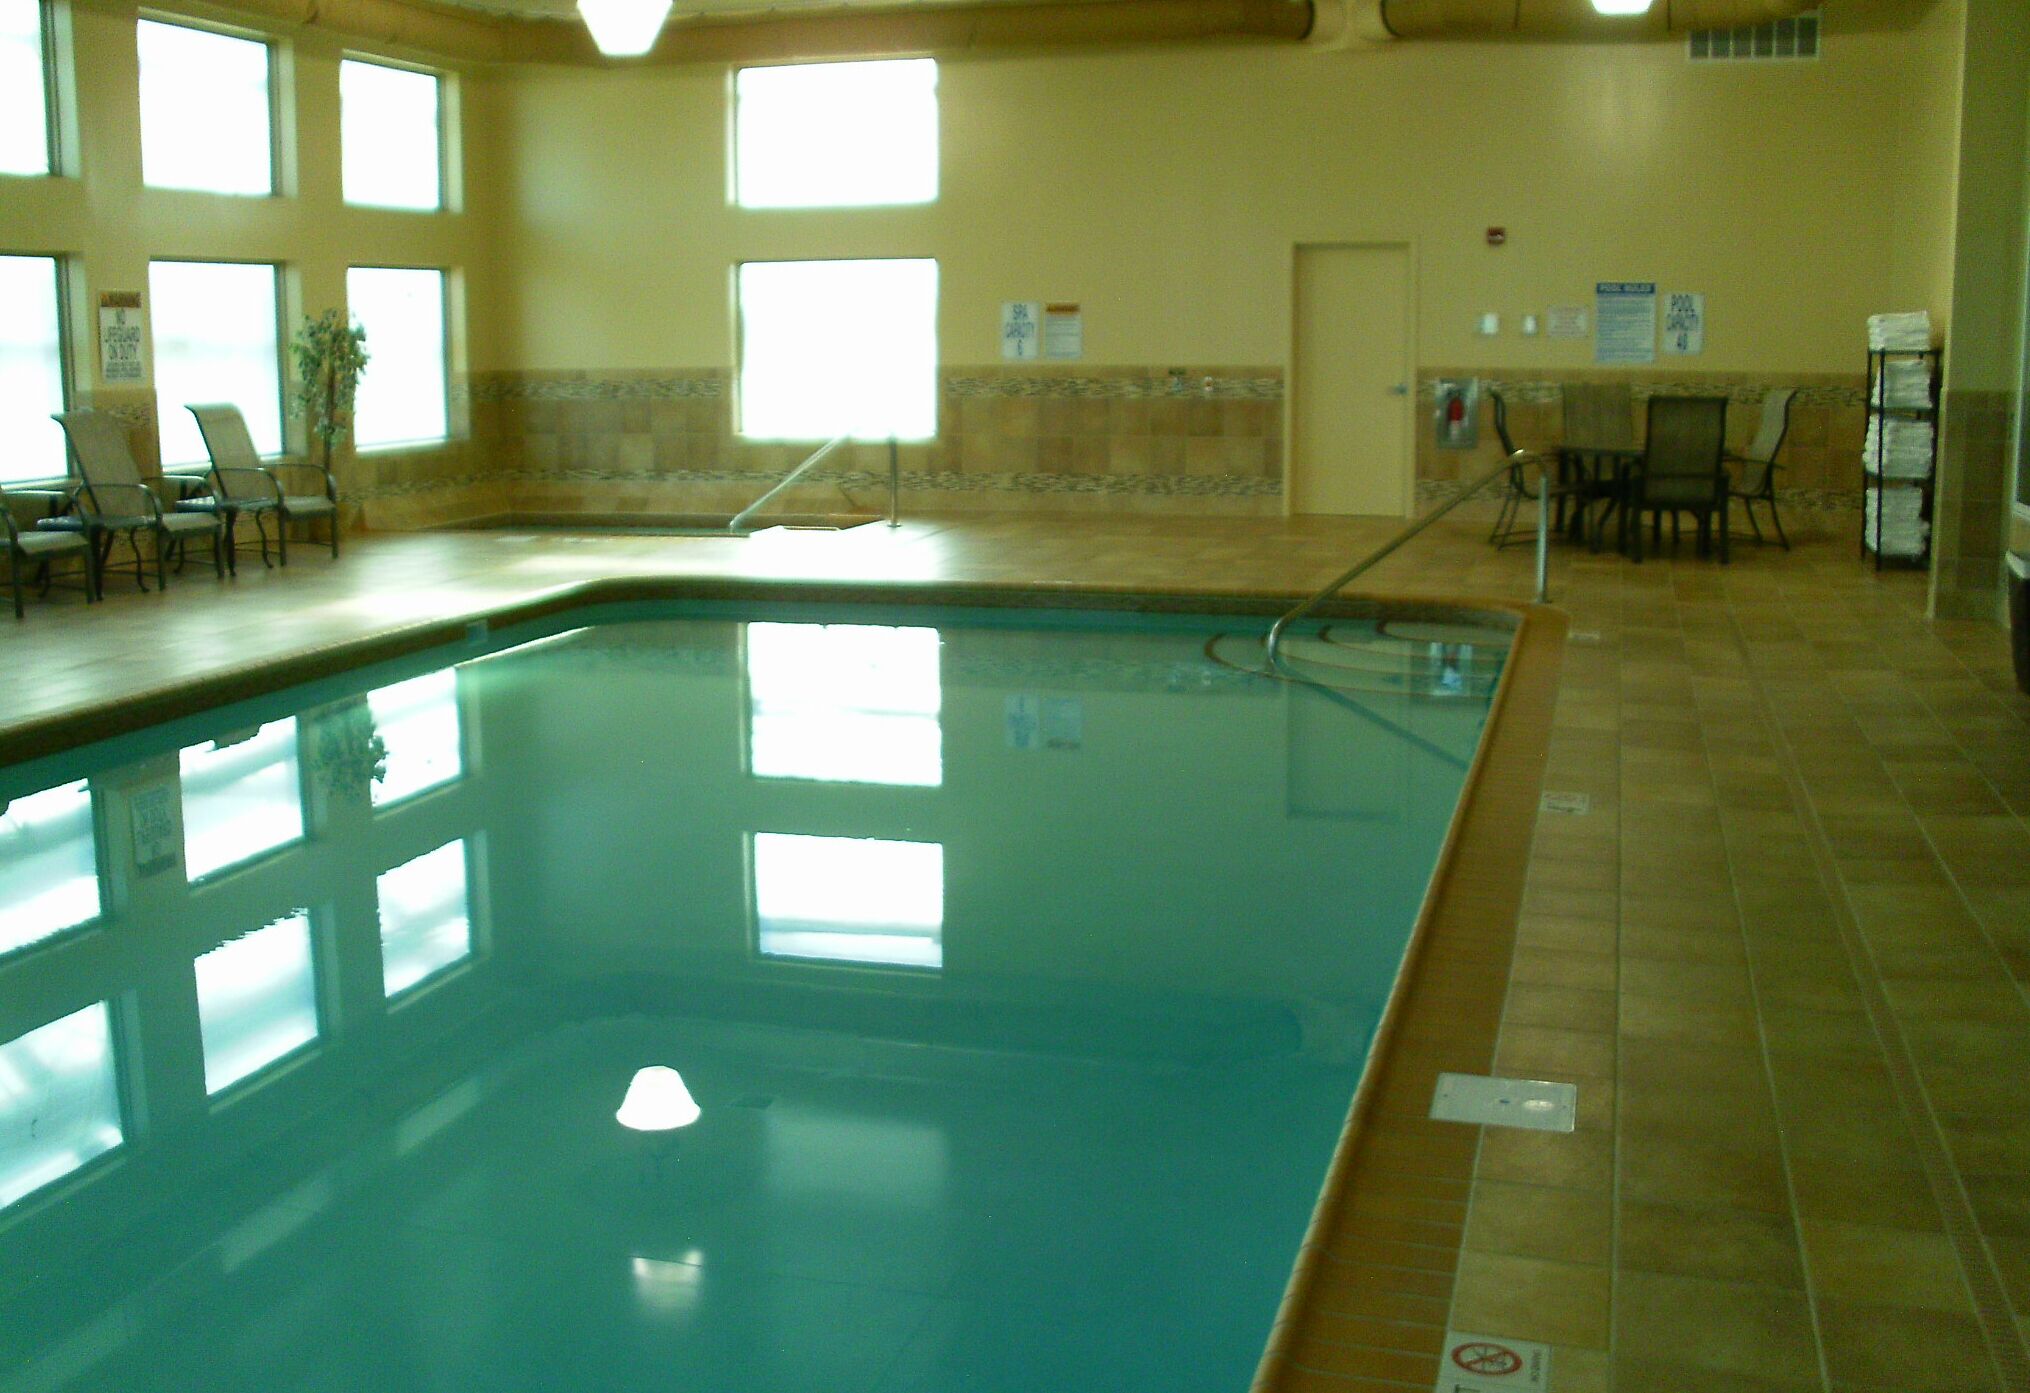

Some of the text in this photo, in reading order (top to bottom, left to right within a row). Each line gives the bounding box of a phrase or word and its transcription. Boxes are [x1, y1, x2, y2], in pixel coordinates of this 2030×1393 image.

[1600, 283, 1622, 292] POOL
[1013, 303, 1028, 320] SPA
[1671, 294, 1695, 312] POOL
[115, 308, 126, 325] NO
[104, 326, 140, 343] LIFEGUARD
[119, 343, 137, 360] DUTY
